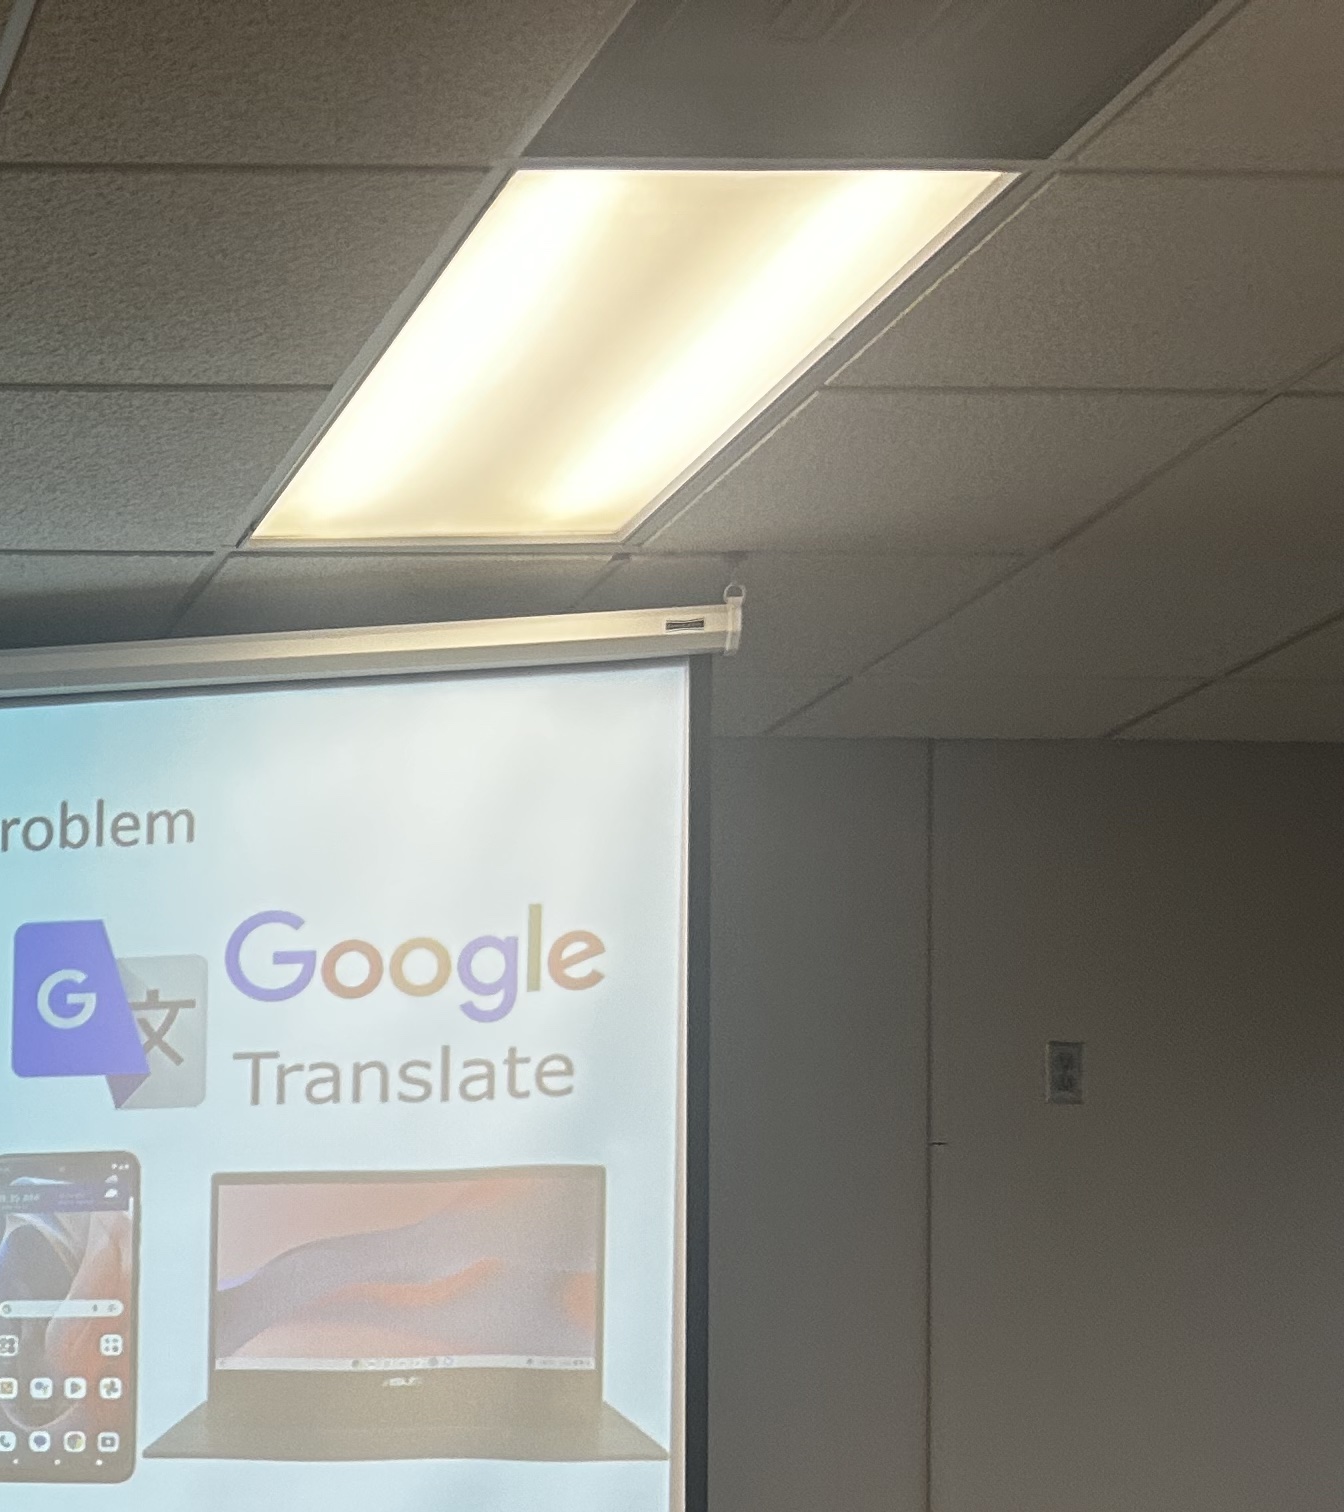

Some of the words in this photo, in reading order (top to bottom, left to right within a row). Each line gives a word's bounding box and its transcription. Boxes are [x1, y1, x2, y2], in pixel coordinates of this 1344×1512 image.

[224, 902, 606, 1023] Google
[36, 968, 97, 1029] G
[232, 1044, 576, 1106] Translate
